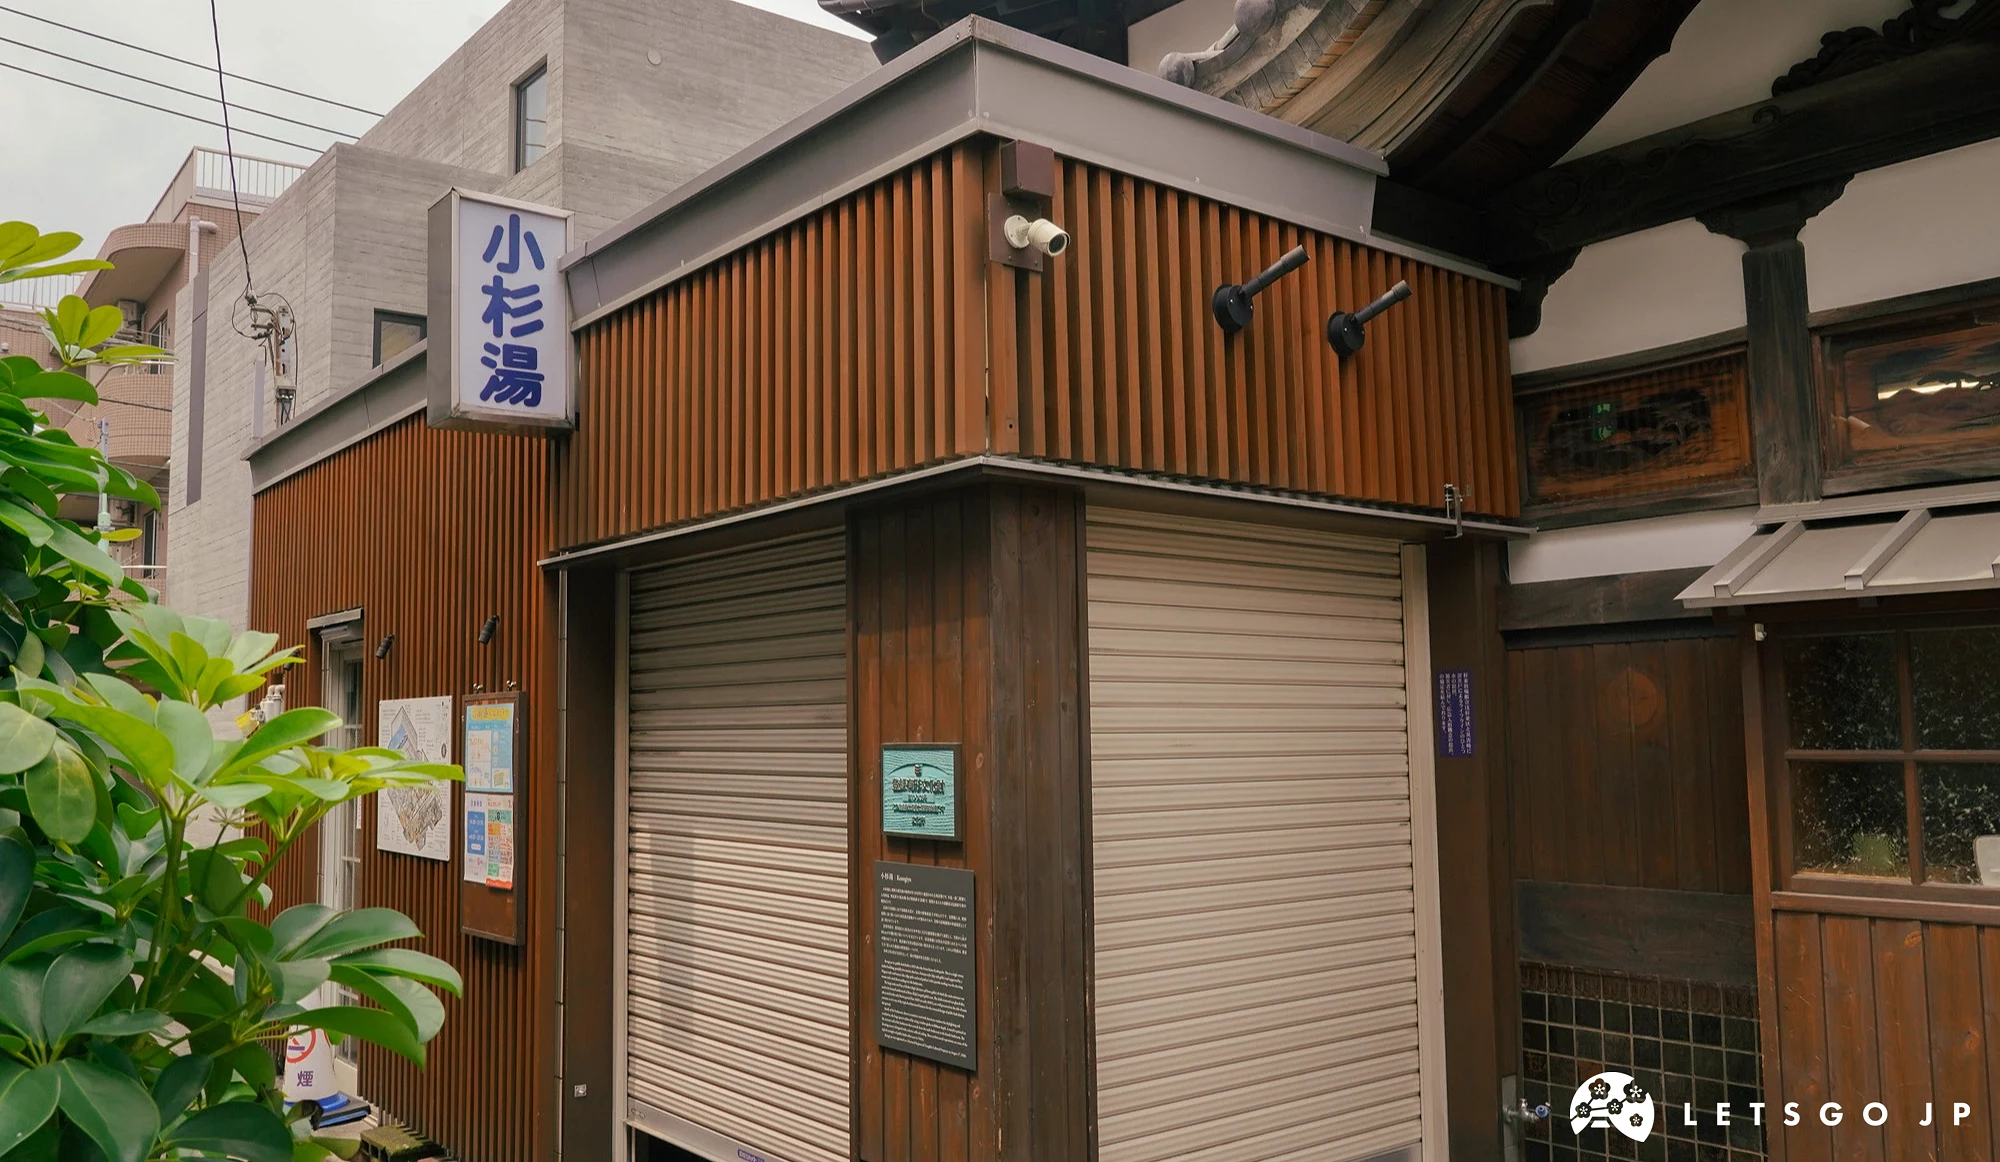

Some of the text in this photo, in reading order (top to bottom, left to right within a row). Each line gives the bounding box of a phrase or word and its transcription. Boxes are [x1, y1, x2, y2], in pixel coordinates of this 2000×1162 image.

[480, 213, 545, 407] 小杉湯
[296, 1070, 314, 1087] 煙
